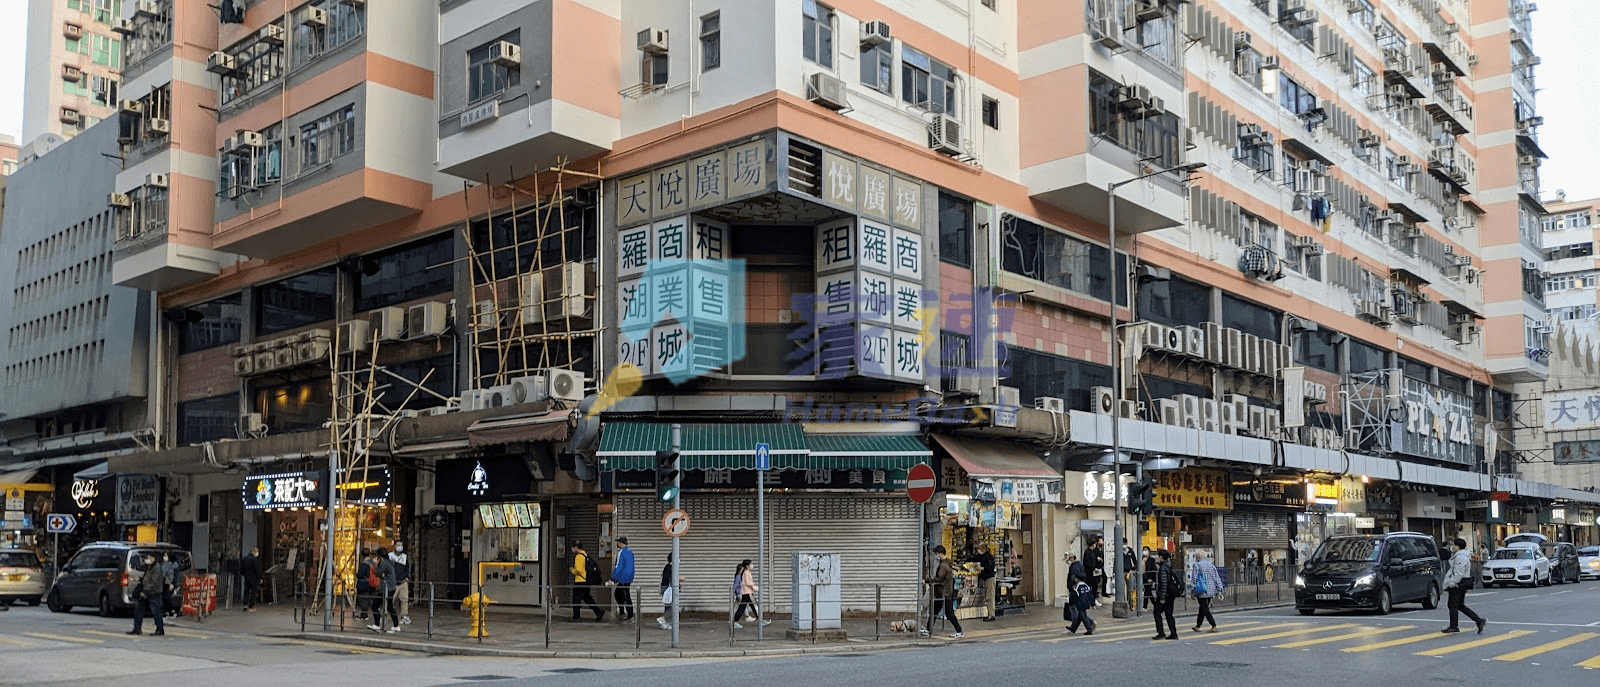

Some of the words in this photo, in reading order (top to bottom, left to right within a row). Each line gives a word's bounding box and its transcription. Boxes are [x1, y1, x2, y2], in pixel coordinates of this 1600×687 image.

[622, 146, 762, 220] 天悅廣場
[828, 160, 918, 224] 悅廣場
[621, 338, 649, 369] 2/F
[863, 334, 889, 365] 2/F
[848, 469, 887, 485] 美食
